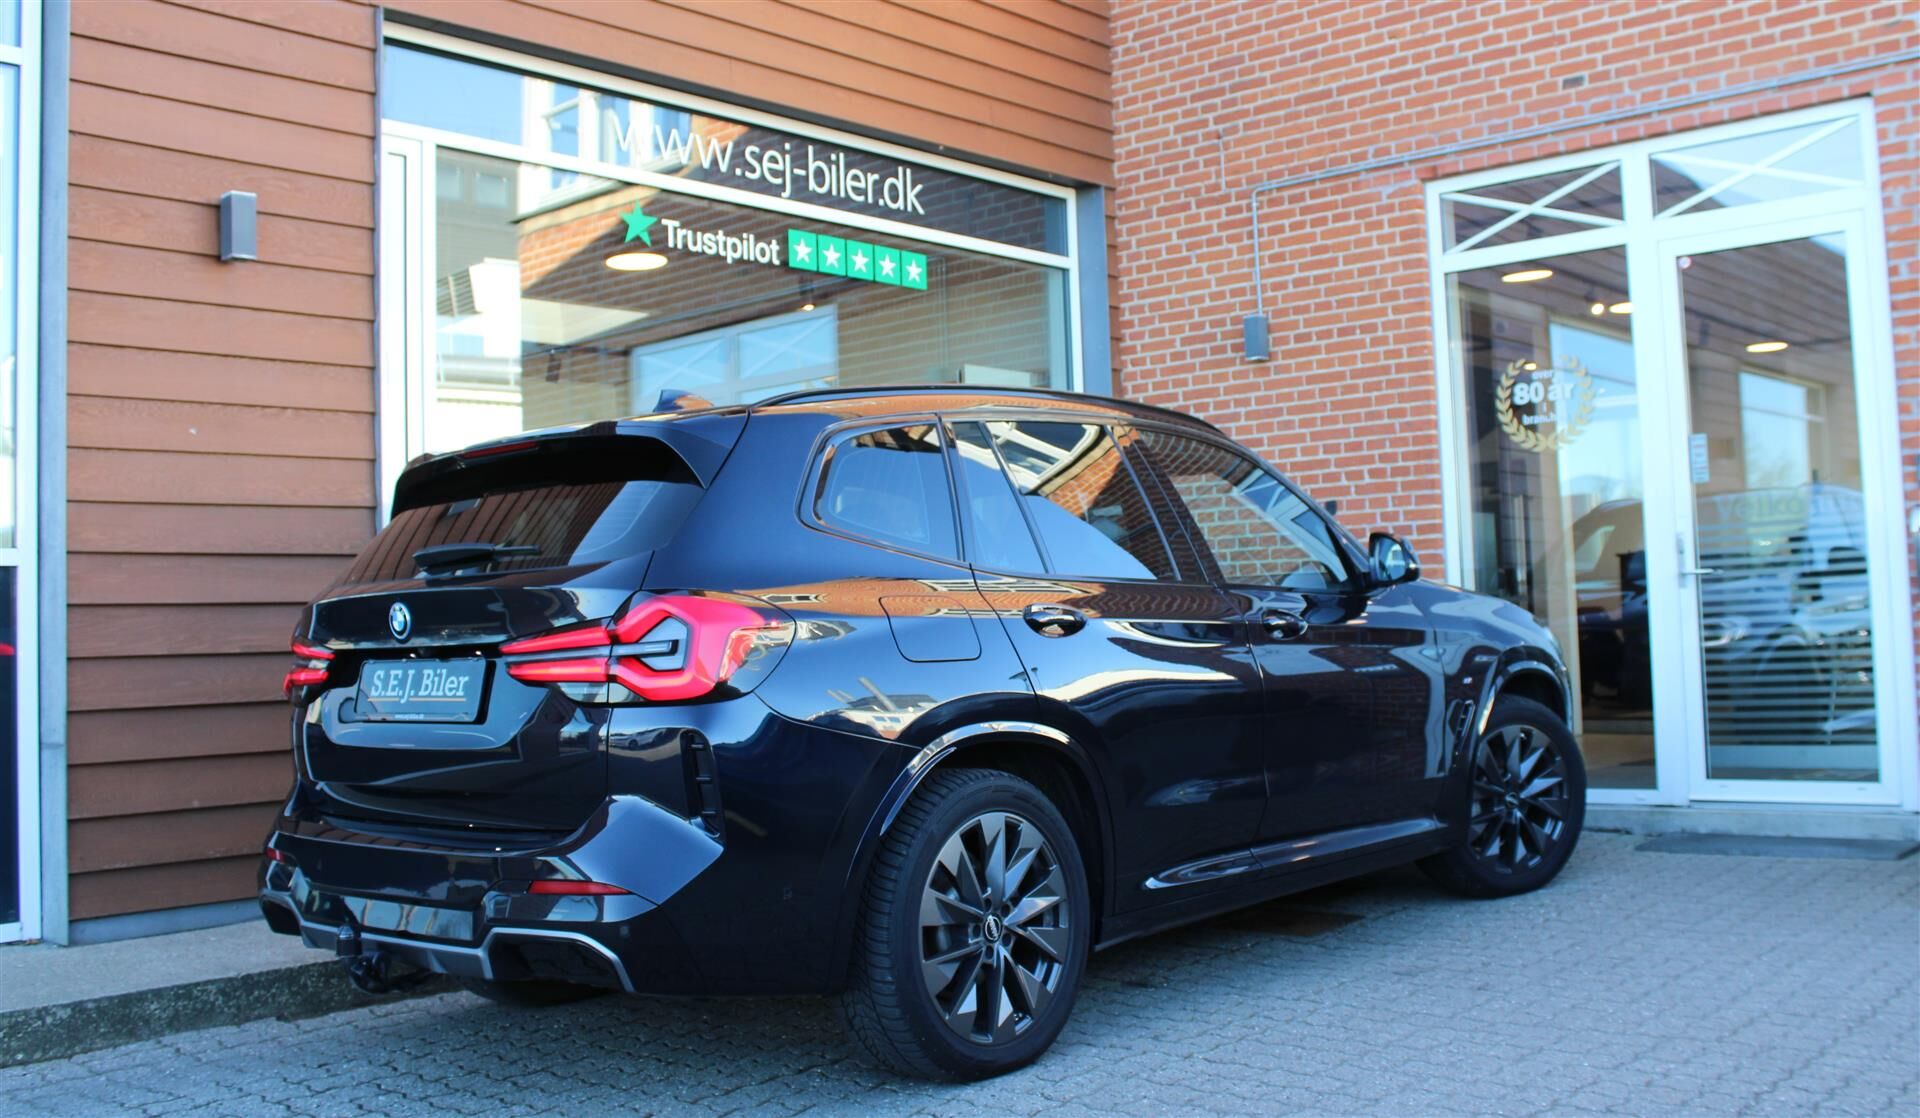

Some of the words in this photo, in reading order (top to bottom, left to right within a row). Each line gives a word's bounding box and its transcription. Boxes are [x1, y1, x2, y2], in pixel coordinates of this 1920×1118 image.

[609, 110, 926, 215] www.sej-biler.dk
[661, 218, 781, 266] Trustpilot
[1513, 382, 1545, 405] 80
[370, 669, 415, 703] S.E.J.
[418, 668, 469, 697] Biler
